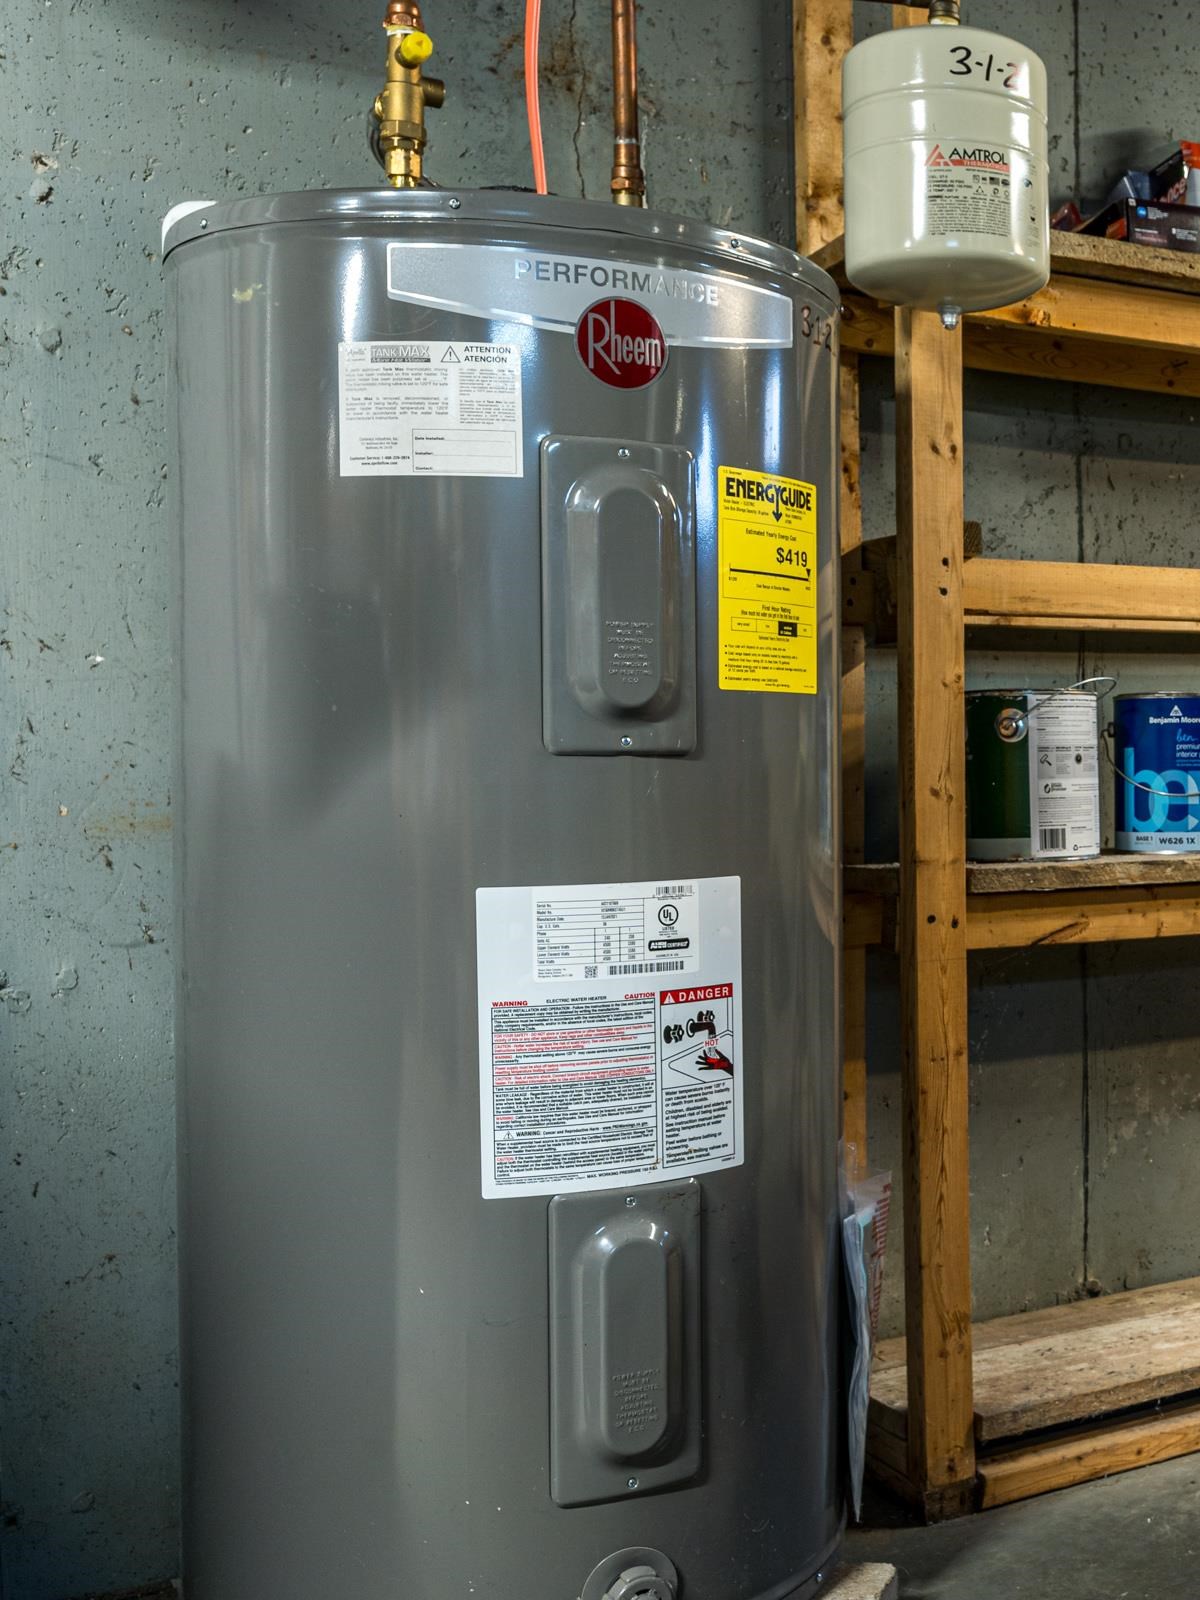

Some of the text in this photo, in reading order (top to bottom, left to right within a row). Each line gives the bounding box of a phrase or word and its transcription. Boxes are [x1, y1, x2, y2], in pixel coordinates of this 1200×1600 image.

[948, 148, 1008, 164] AMTROL
[514, 258, 719, 306] PERFORMANCE
[588, 300, 662, 375] Rheem
[372, 346, 430, 358] TANK MAX
[464, 346, 511, 354] ATTENTION
[464, 354, 508, 363] ATENCIÓN
[726, 477, 812, 512] ENERGYGUIDE
[776, 547, 807, 567] $419
[1149, 716, 1180, 724] Benjamin
[1176, 728, 1198, 742] ben
[679, 987, 728, 1001] DANGER
[704, 1039, 719, 1047] HOT
[678, 1086, 703, 1094] temperature
[681, 1122, 705, 1130] temperature
